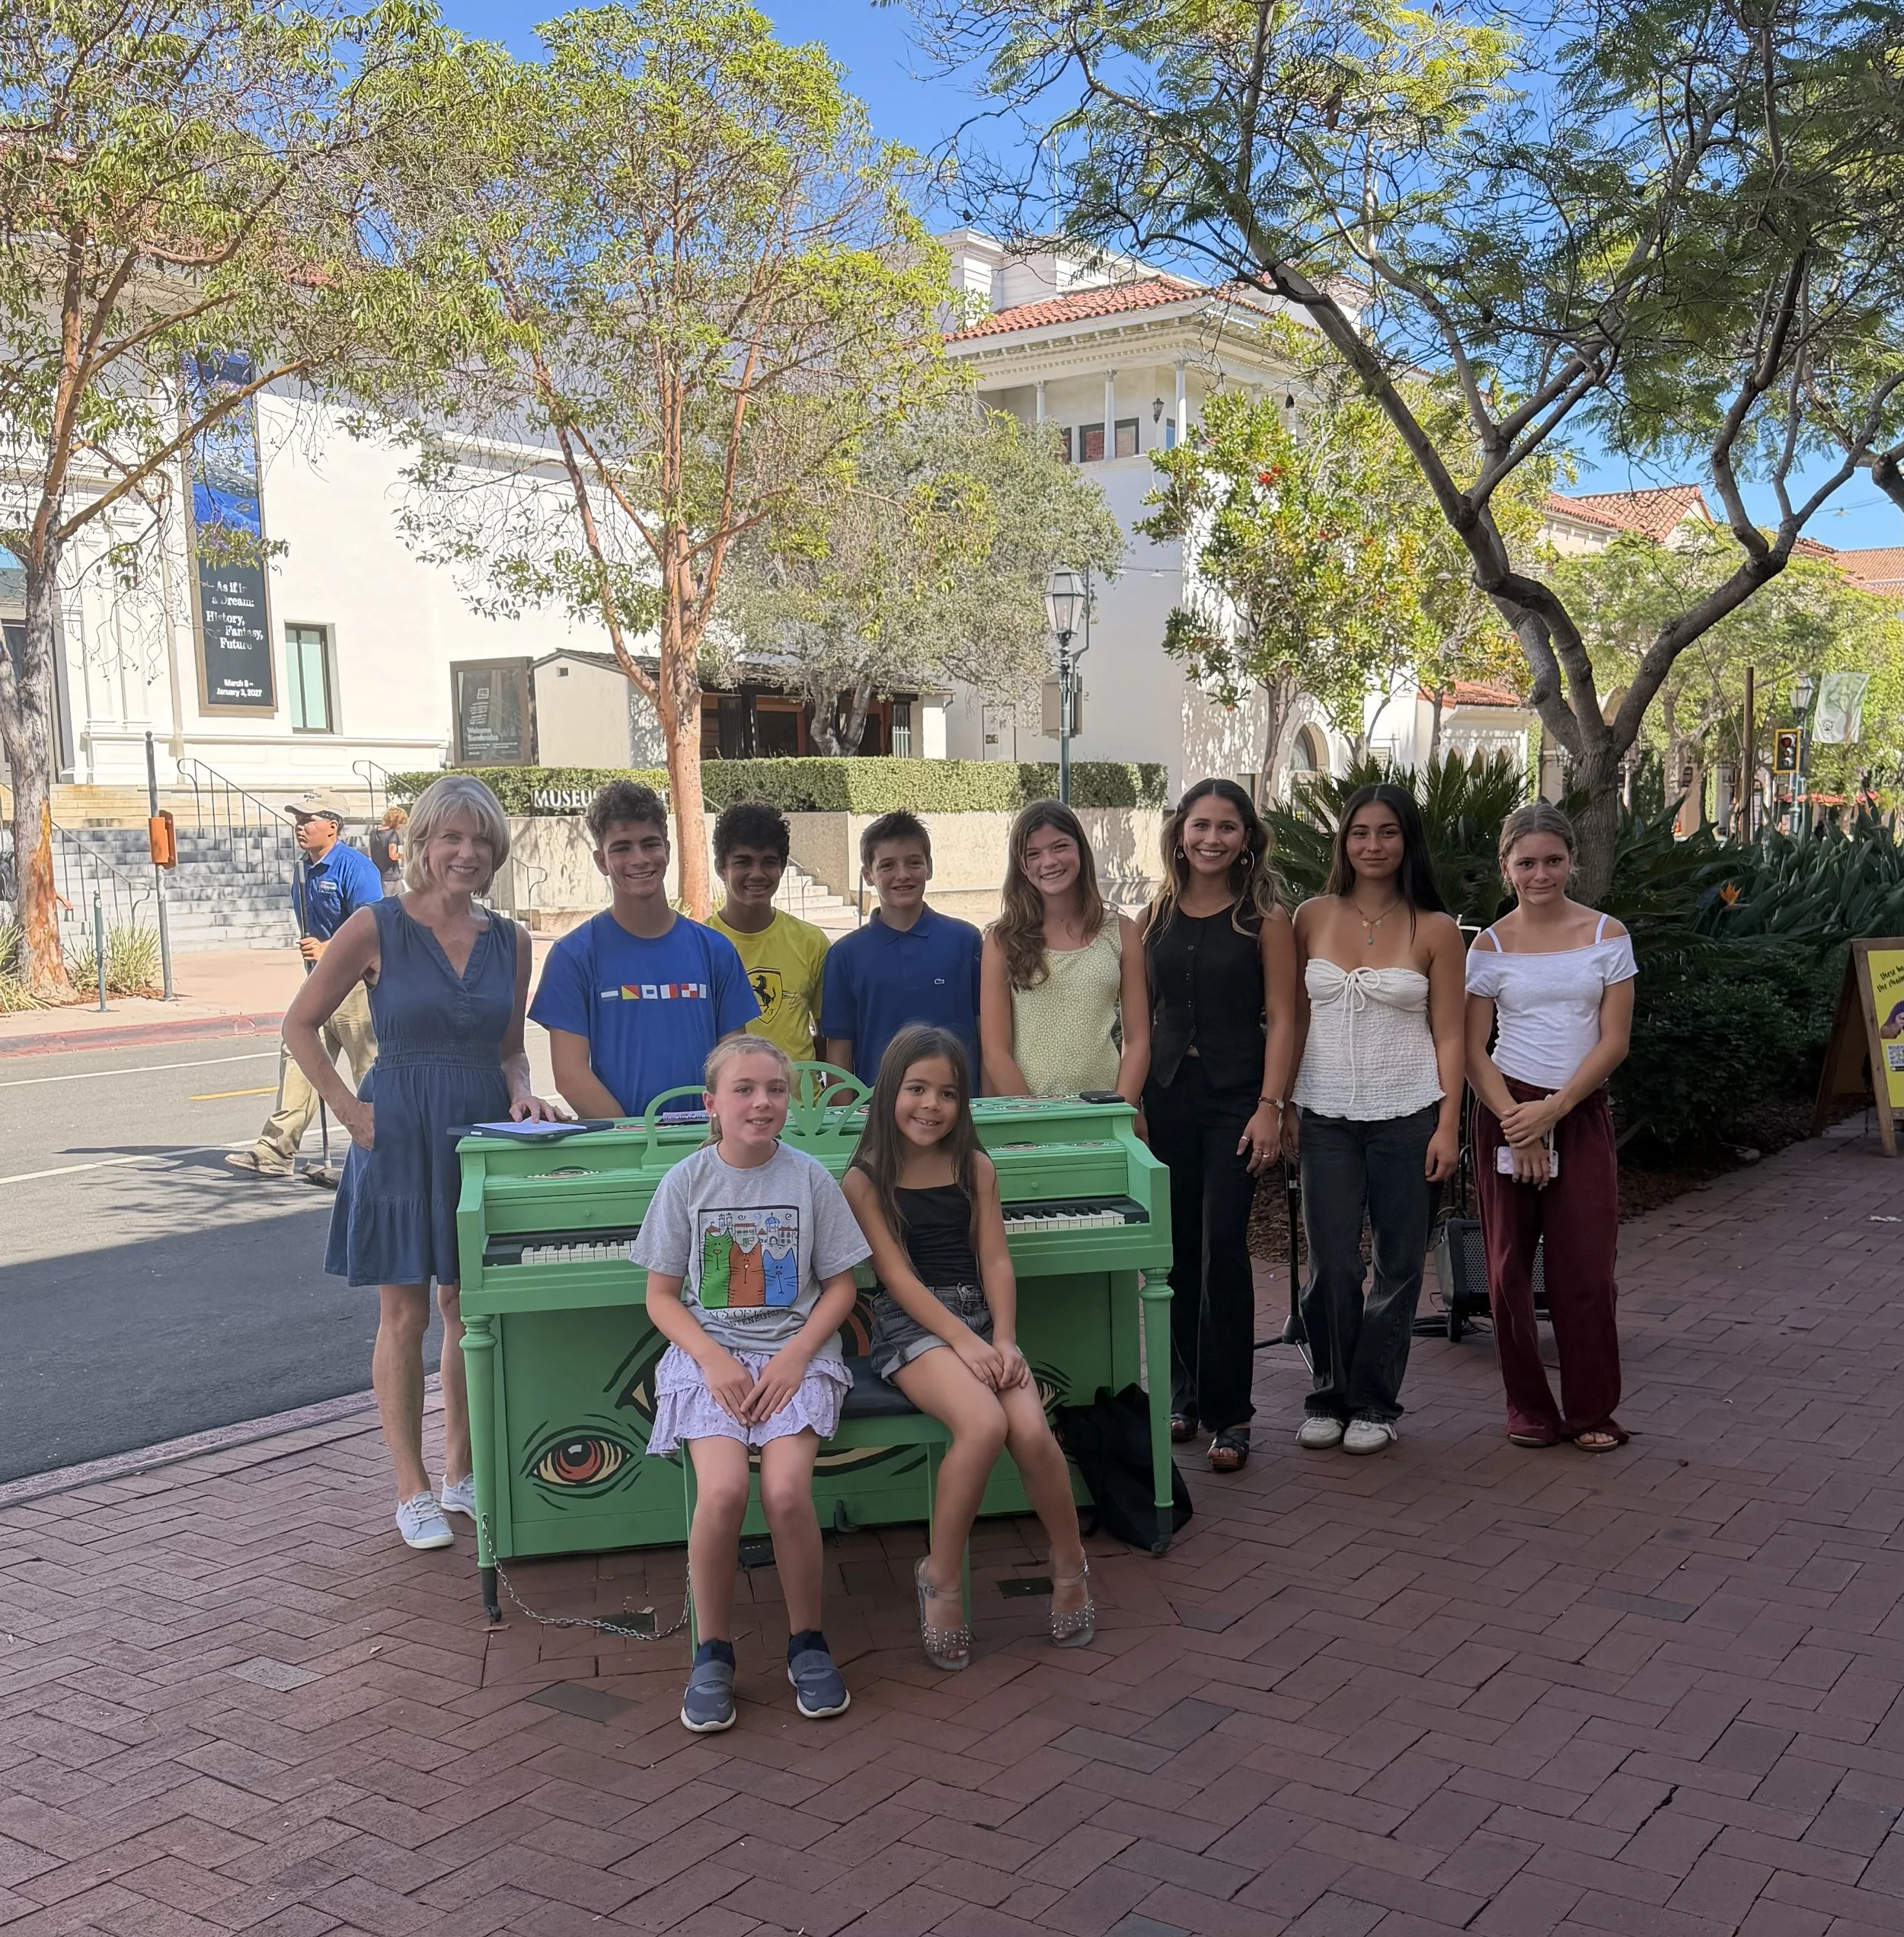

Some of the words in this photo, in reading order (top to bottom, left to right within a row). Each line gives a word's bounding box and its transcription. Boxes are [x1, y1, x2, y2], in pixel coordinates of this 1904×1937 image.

[216, 580, 228, 592] As
[229, 582, 238, 593] if
[220, 594, 254, 607] Dream:
[206, 610, 245, 626] History,
[225, 625, 264, 641] Fantasy,
[224, 679, 244, 687] March
[216, 688, 240, 697] January
[534, 789, 597, 807] MUSEU
[724, 1309, 780, 1327] ONTENEGRO
